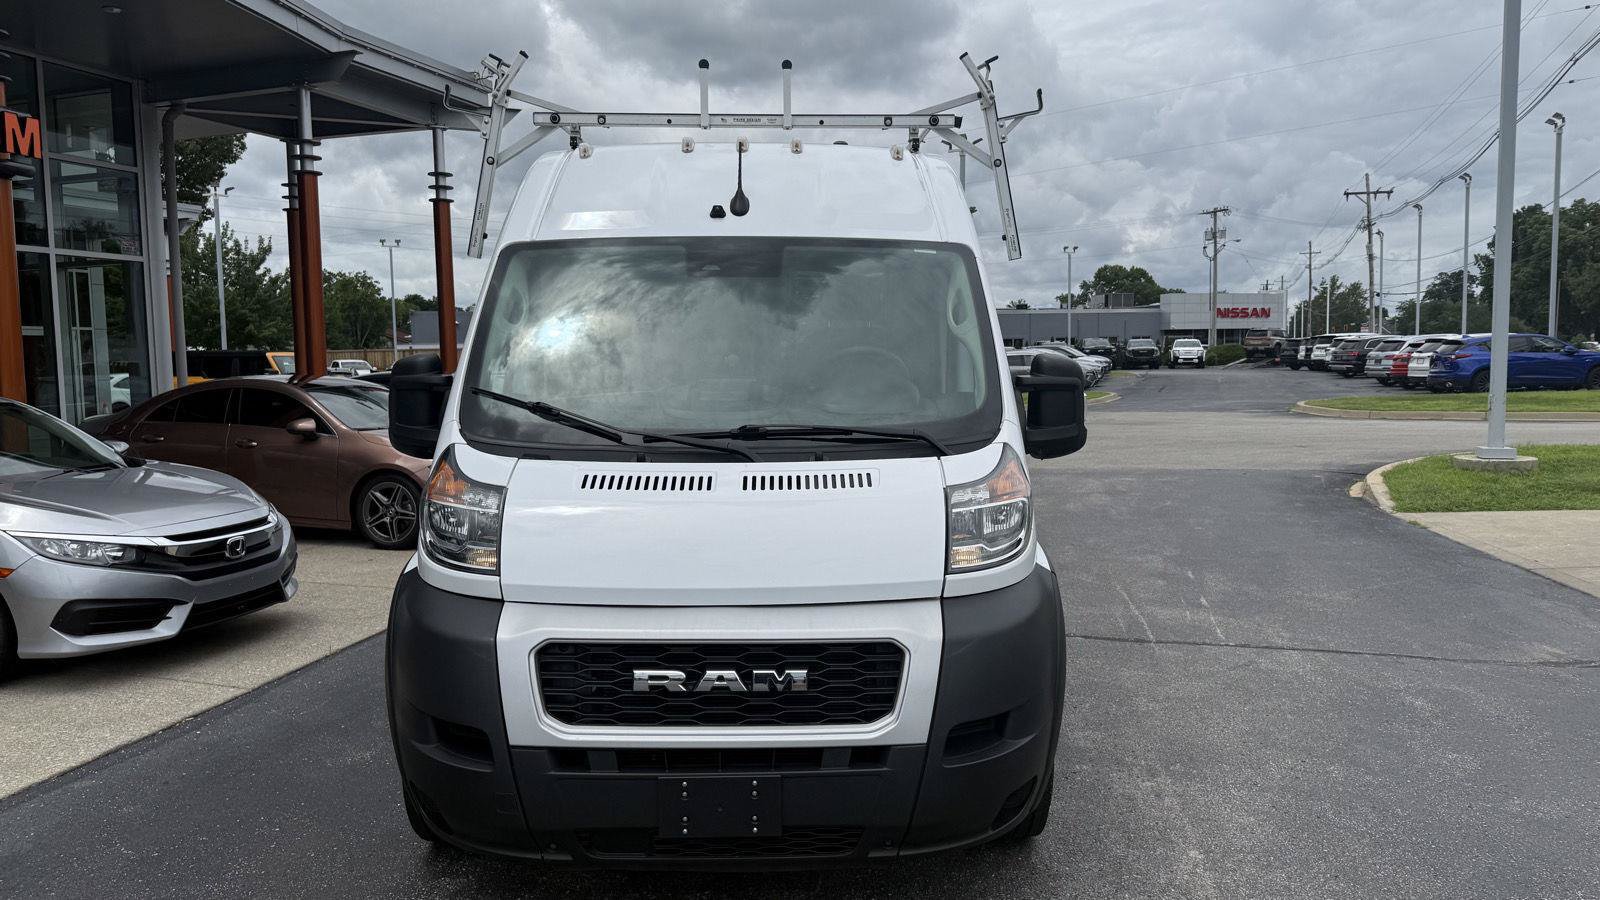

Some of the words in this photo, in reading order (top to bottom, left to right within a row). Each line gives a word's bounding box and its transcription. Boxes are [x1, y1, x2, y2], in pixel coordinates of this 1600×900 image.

[4, 111, 42, 160] M
[1216, 307, 1271, 319] NISSAN
[633, 670, 808, 692] RAM
